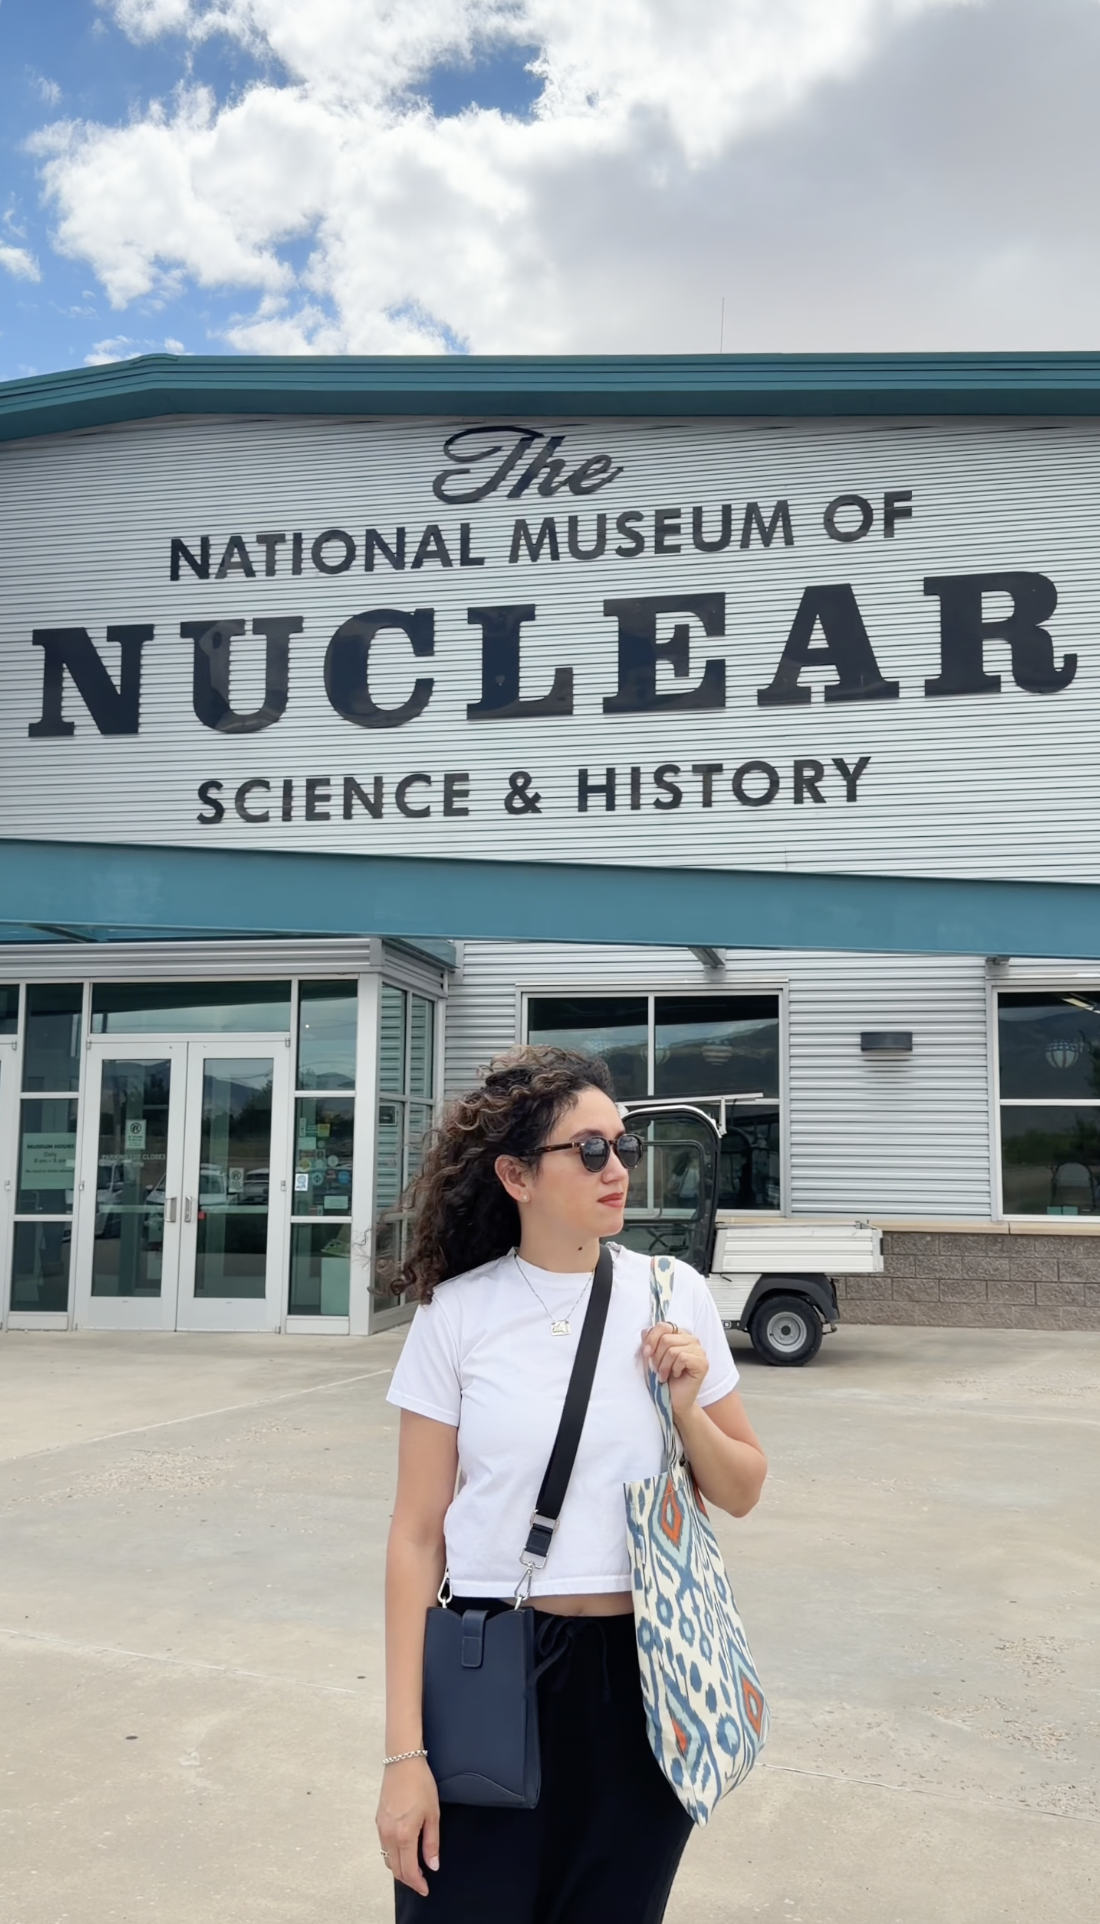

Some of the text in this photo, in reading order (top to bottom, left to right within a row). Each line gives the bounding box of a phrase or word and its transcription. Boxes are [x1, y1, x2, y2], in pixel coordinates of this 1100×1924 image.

[432, 426, 624, 504] The
[170, 491, 913, 581] NATIONAL MUSEUM OF
[28, 571, 1077, 738] NUCLEAR
[197, 757, 872, 825] SCIENCE & HISTORY
